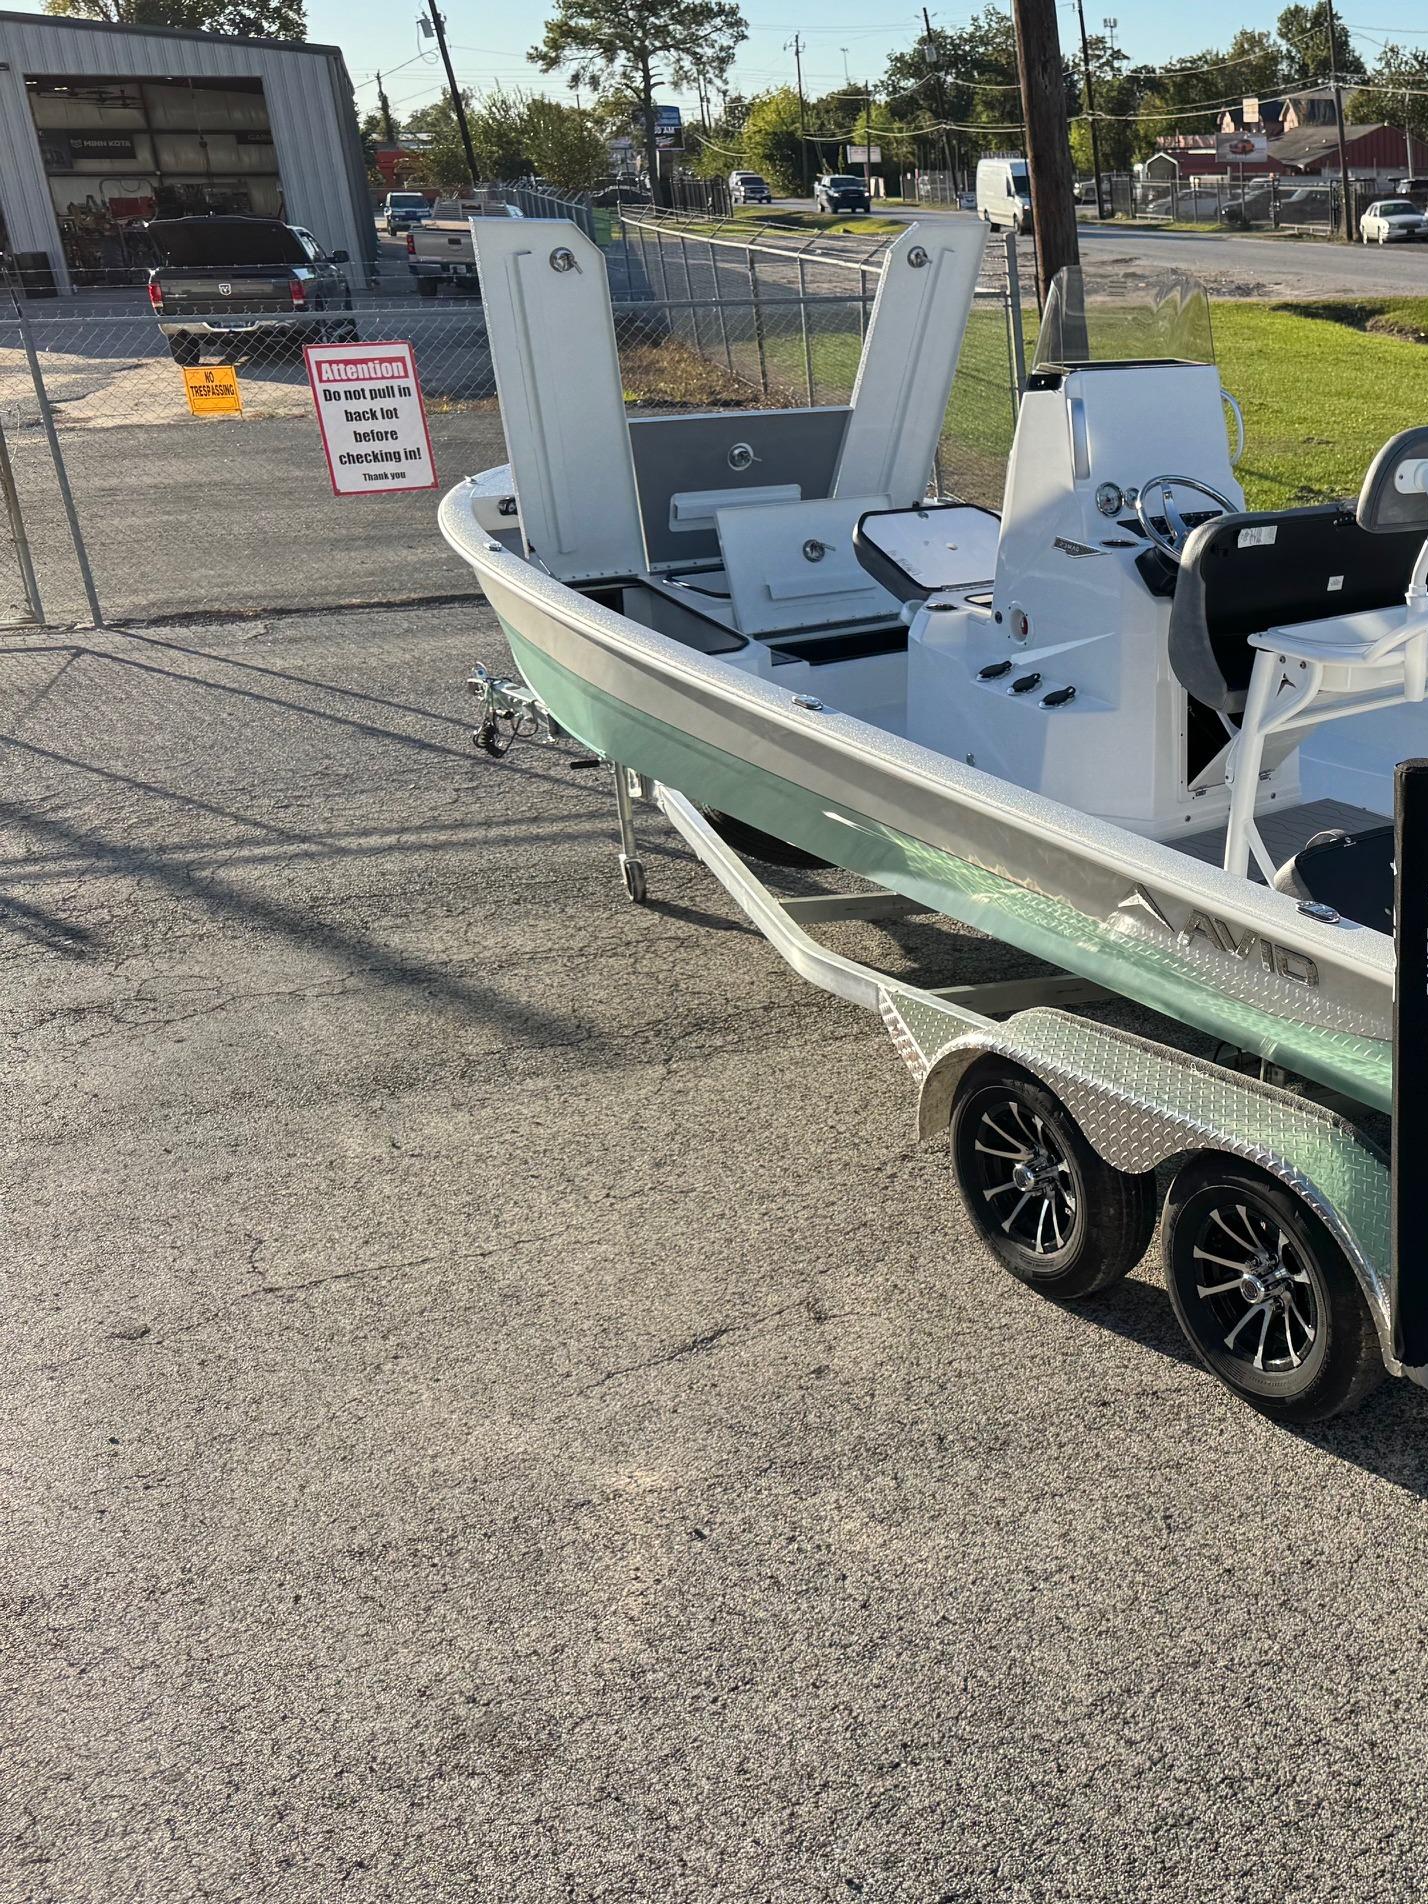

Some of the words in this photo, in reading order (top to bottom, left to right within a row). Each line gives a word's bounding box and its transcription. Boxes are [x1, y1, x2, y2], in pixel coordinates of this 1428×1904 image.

[204, 371, 215, 383] NO
[321, 360, 405, 381] Attention
[190, 384, 235, 397] TRESPASSING
[323, 389, 341, 402] Do
[344, 388, 367, 401] not
[369, 385, 395, 401] pull
[398, 385, 412, 397] in
[344, 408, 378, 422] back
[381, 407, 400, 420] lot
[353, 430, 398, 443] before
[338, 449, 401, 465] checking
[404, 447, 422, 461] in!
[362, 472, 389, 482] Thank
[390, 471, 406, 480] you
[1177, 908, 1320, 988] AVID
